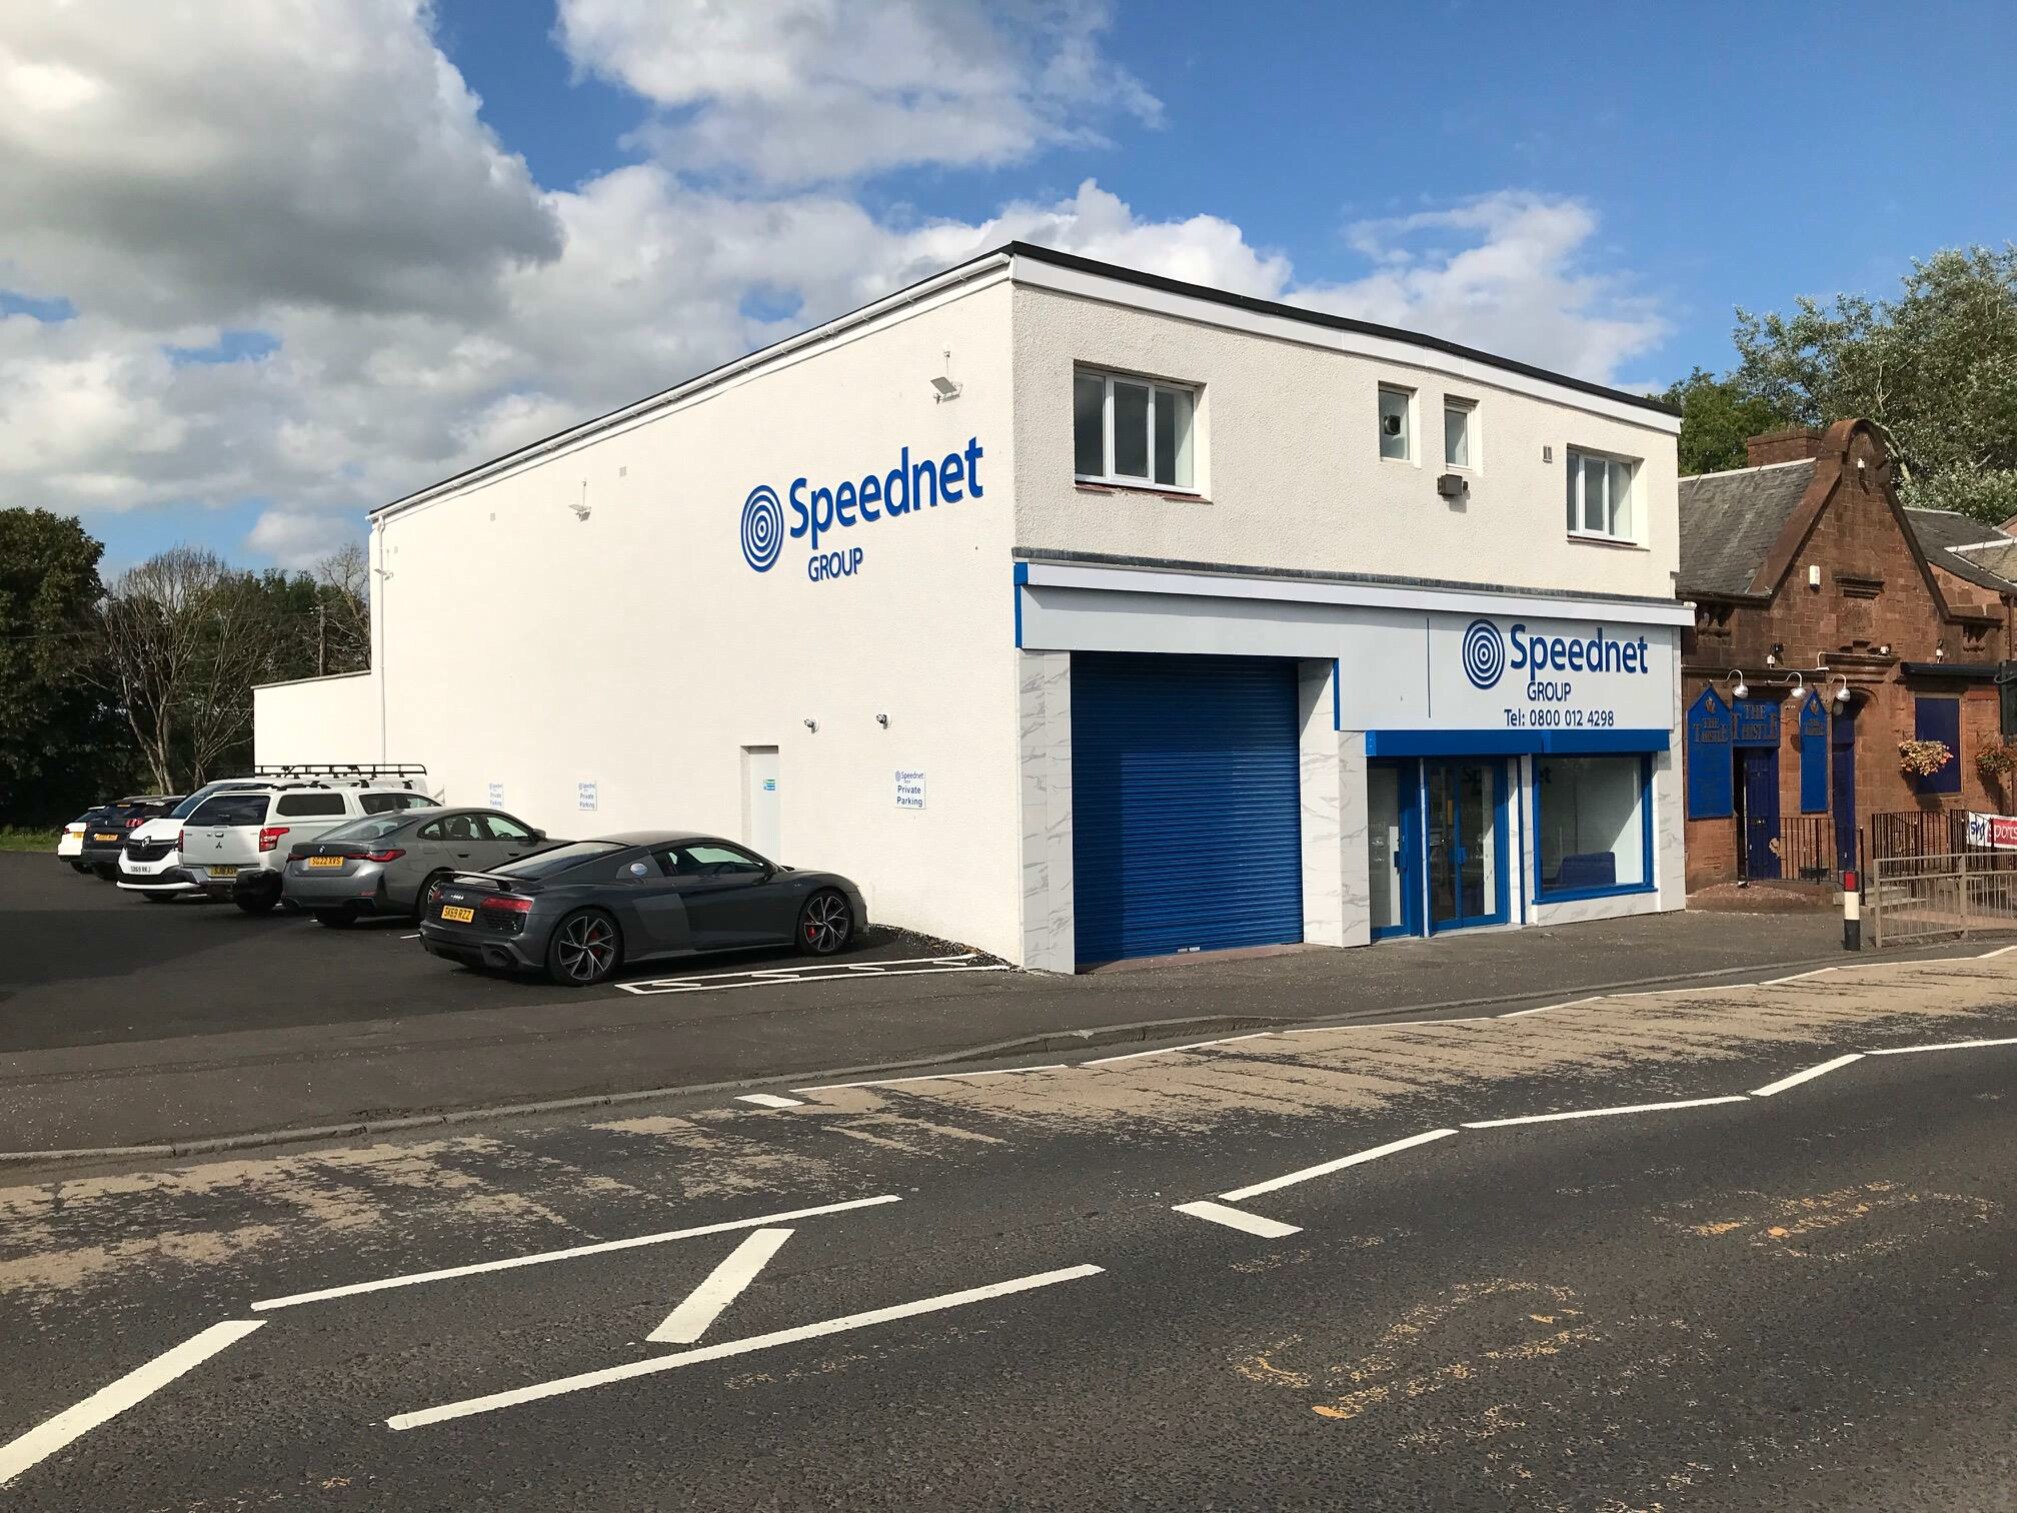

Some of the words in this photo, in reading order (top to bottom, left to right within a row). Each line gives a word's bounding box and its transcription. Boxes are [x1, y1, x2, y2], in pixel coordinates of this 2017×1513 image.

[789, 436, 984, 551] Speednet
[807, 547, 864, 582] GROUP
[1510, 624, 1649, 681] Speednet
[1526, 682, 1572, 702] GROUP
[1503, 708, 1525, 727] Tel:
[1529, 709, 1561, 727] 0800
[1564, 710, 1584, 727] 012
[1586, 710, 1615, 728] 4298
[897, 785, 921, 794] Private
[896, 796, 923, 808] Parking
